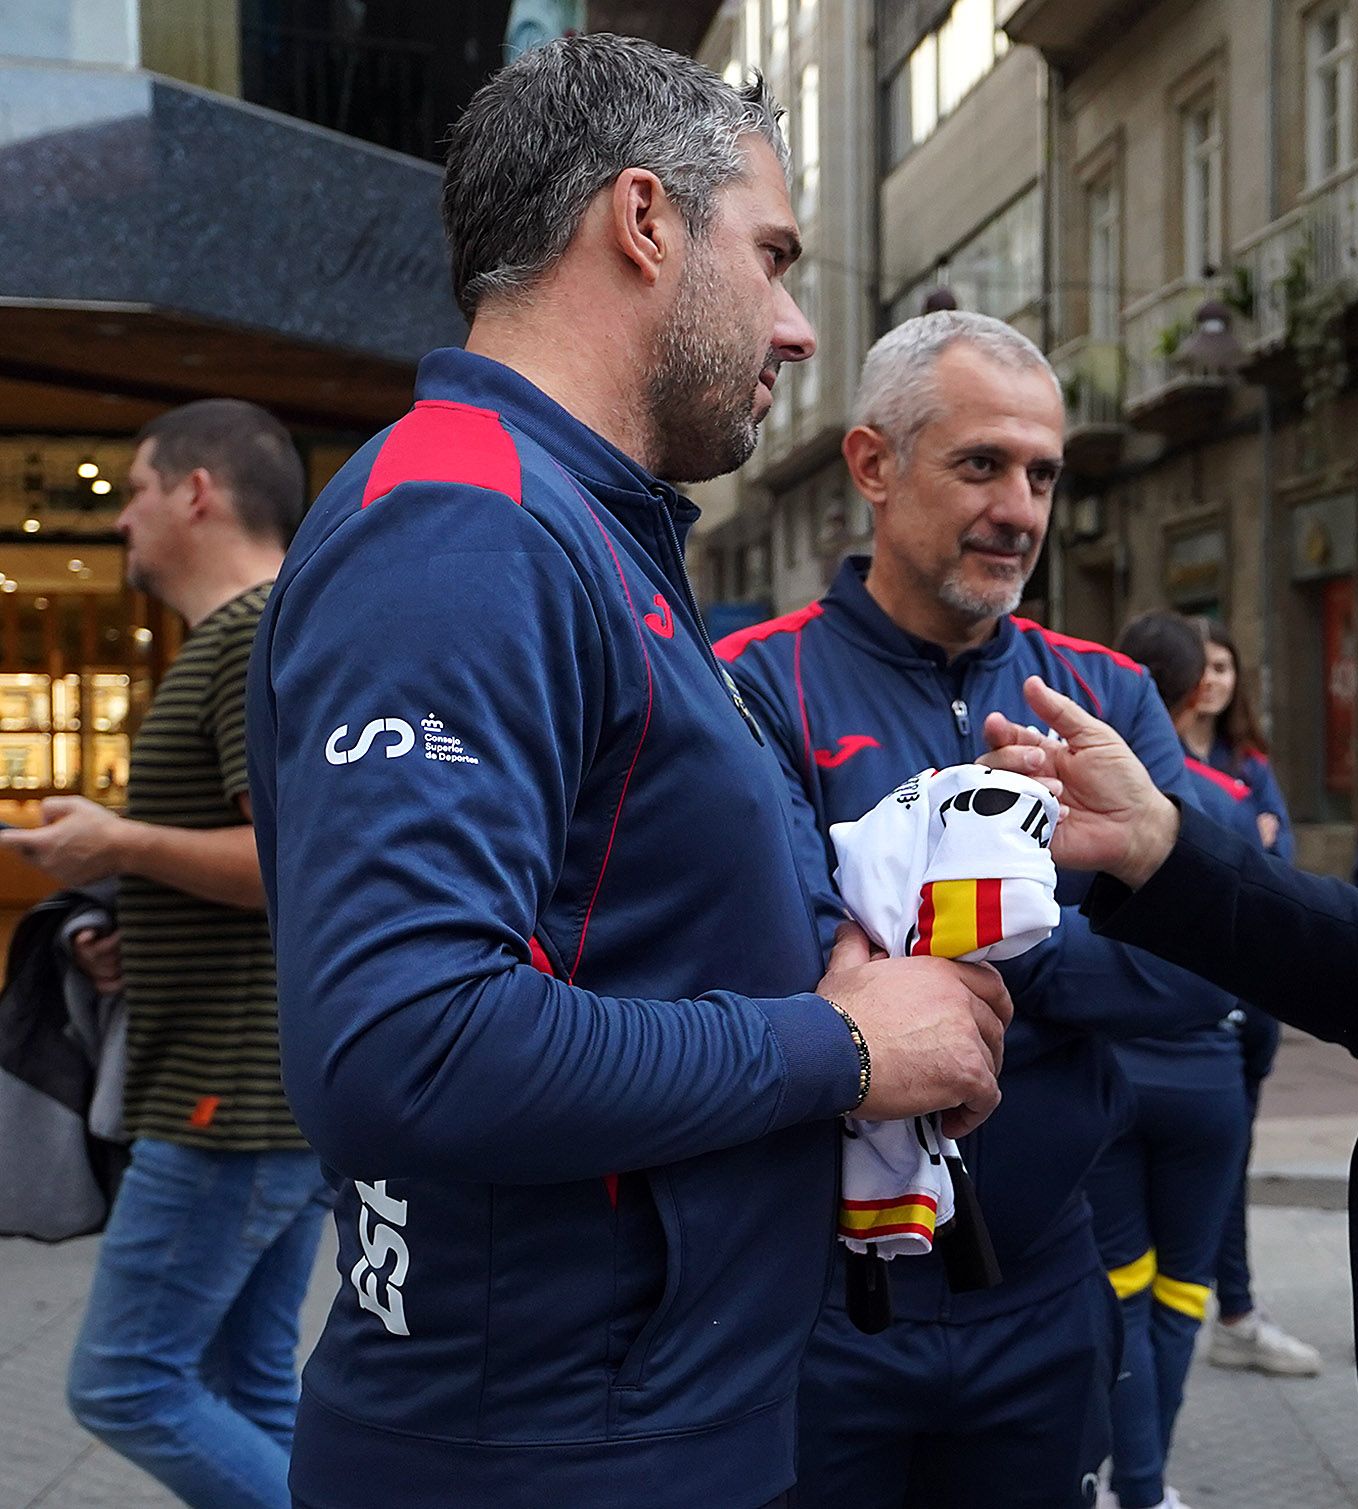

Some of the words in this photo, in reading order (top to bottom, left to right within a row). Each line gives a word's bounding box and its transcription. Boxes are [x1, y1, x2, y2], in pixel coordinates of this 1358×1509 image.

[424, 733, 461, 747] Consejo
[425, 742, 464, 754] Superior
[425, 752, 438, 760] de
[438, 753, 479, 764] Deportes
